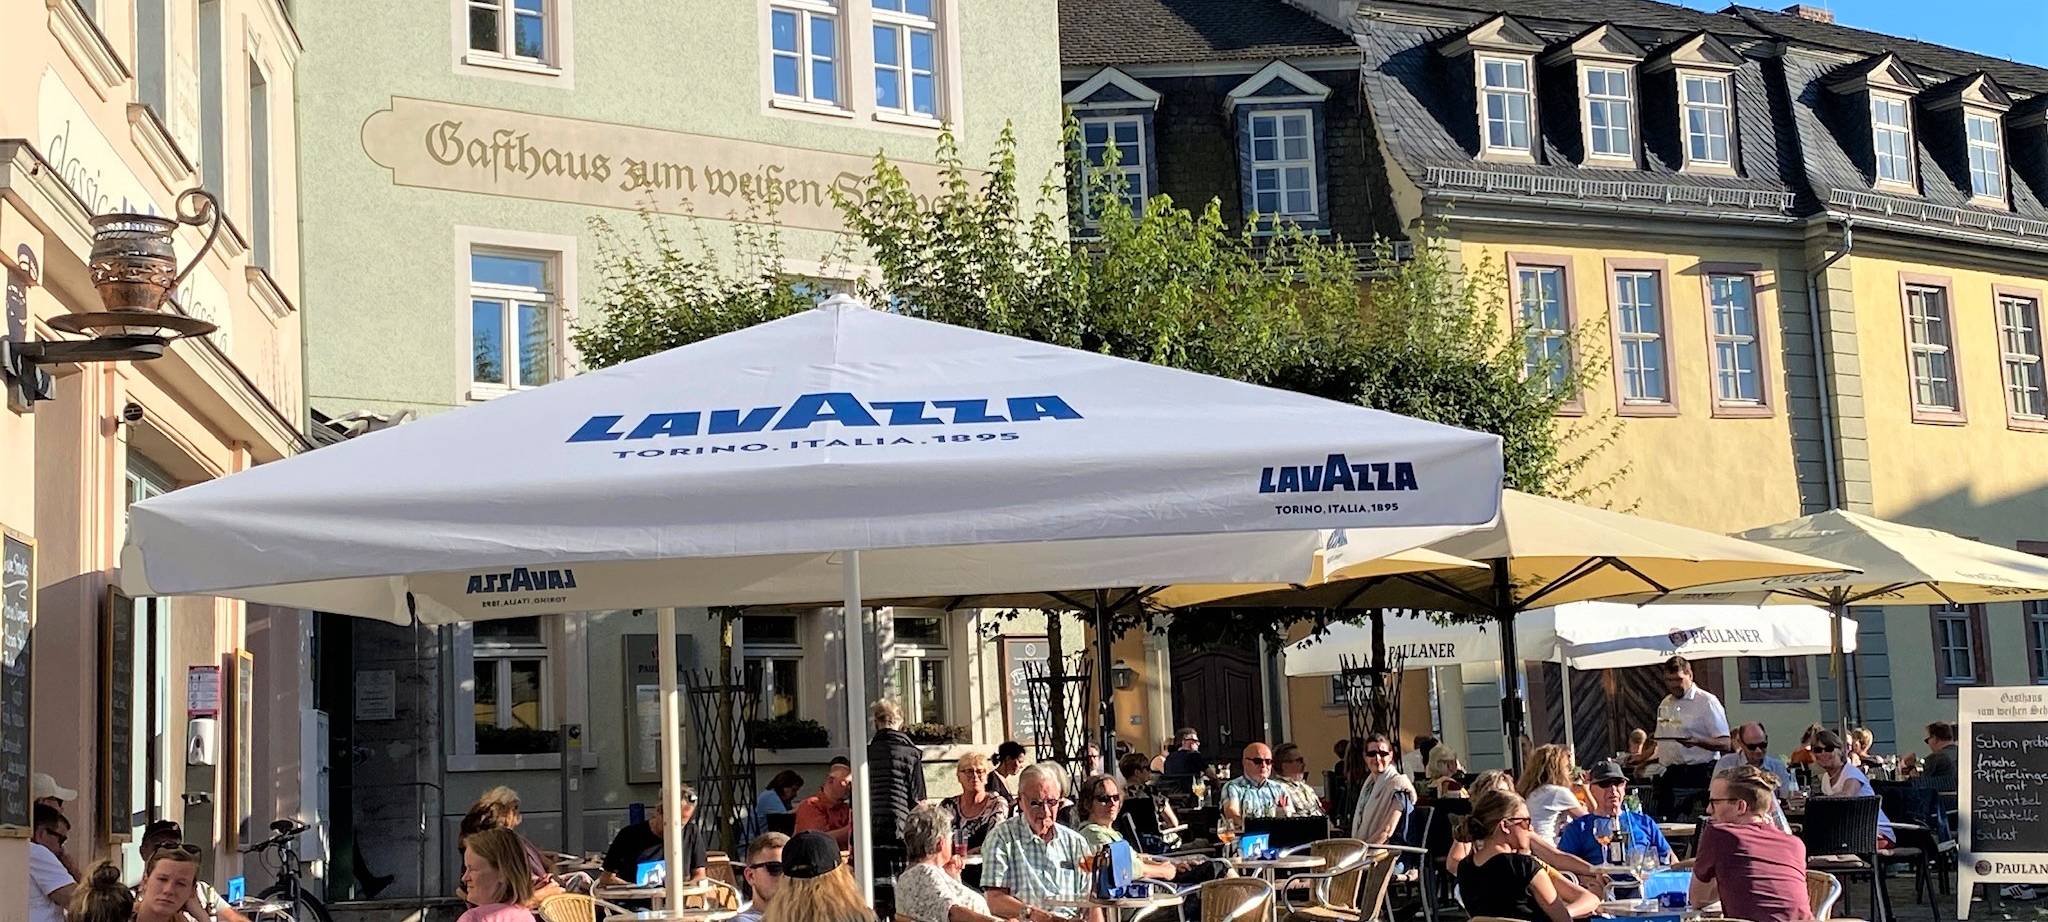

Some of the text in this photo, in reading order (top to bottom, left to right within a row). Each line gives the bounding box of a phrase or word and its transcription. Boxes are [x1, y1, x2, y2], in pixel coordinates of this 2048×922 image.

[619, 156, 698, 193] zum
[565, 391, 1085, 443] LAVAZZA
[931, 431, 1020, 443] 1895
[1259, 453, 1419, 494] LAVAZZA
[1371, 502, 1399, 513] 1895
[1692, 628, 1764, 645] PAULANER
[1975, 733, 2018, 749] Schon
[1976, 752, 2017, 770] frische
[2005, 780, 2028, 791] mit
[1976, 792, 2042, 807] Schnitzel
[1976, 826, 2018, 841] Salat
